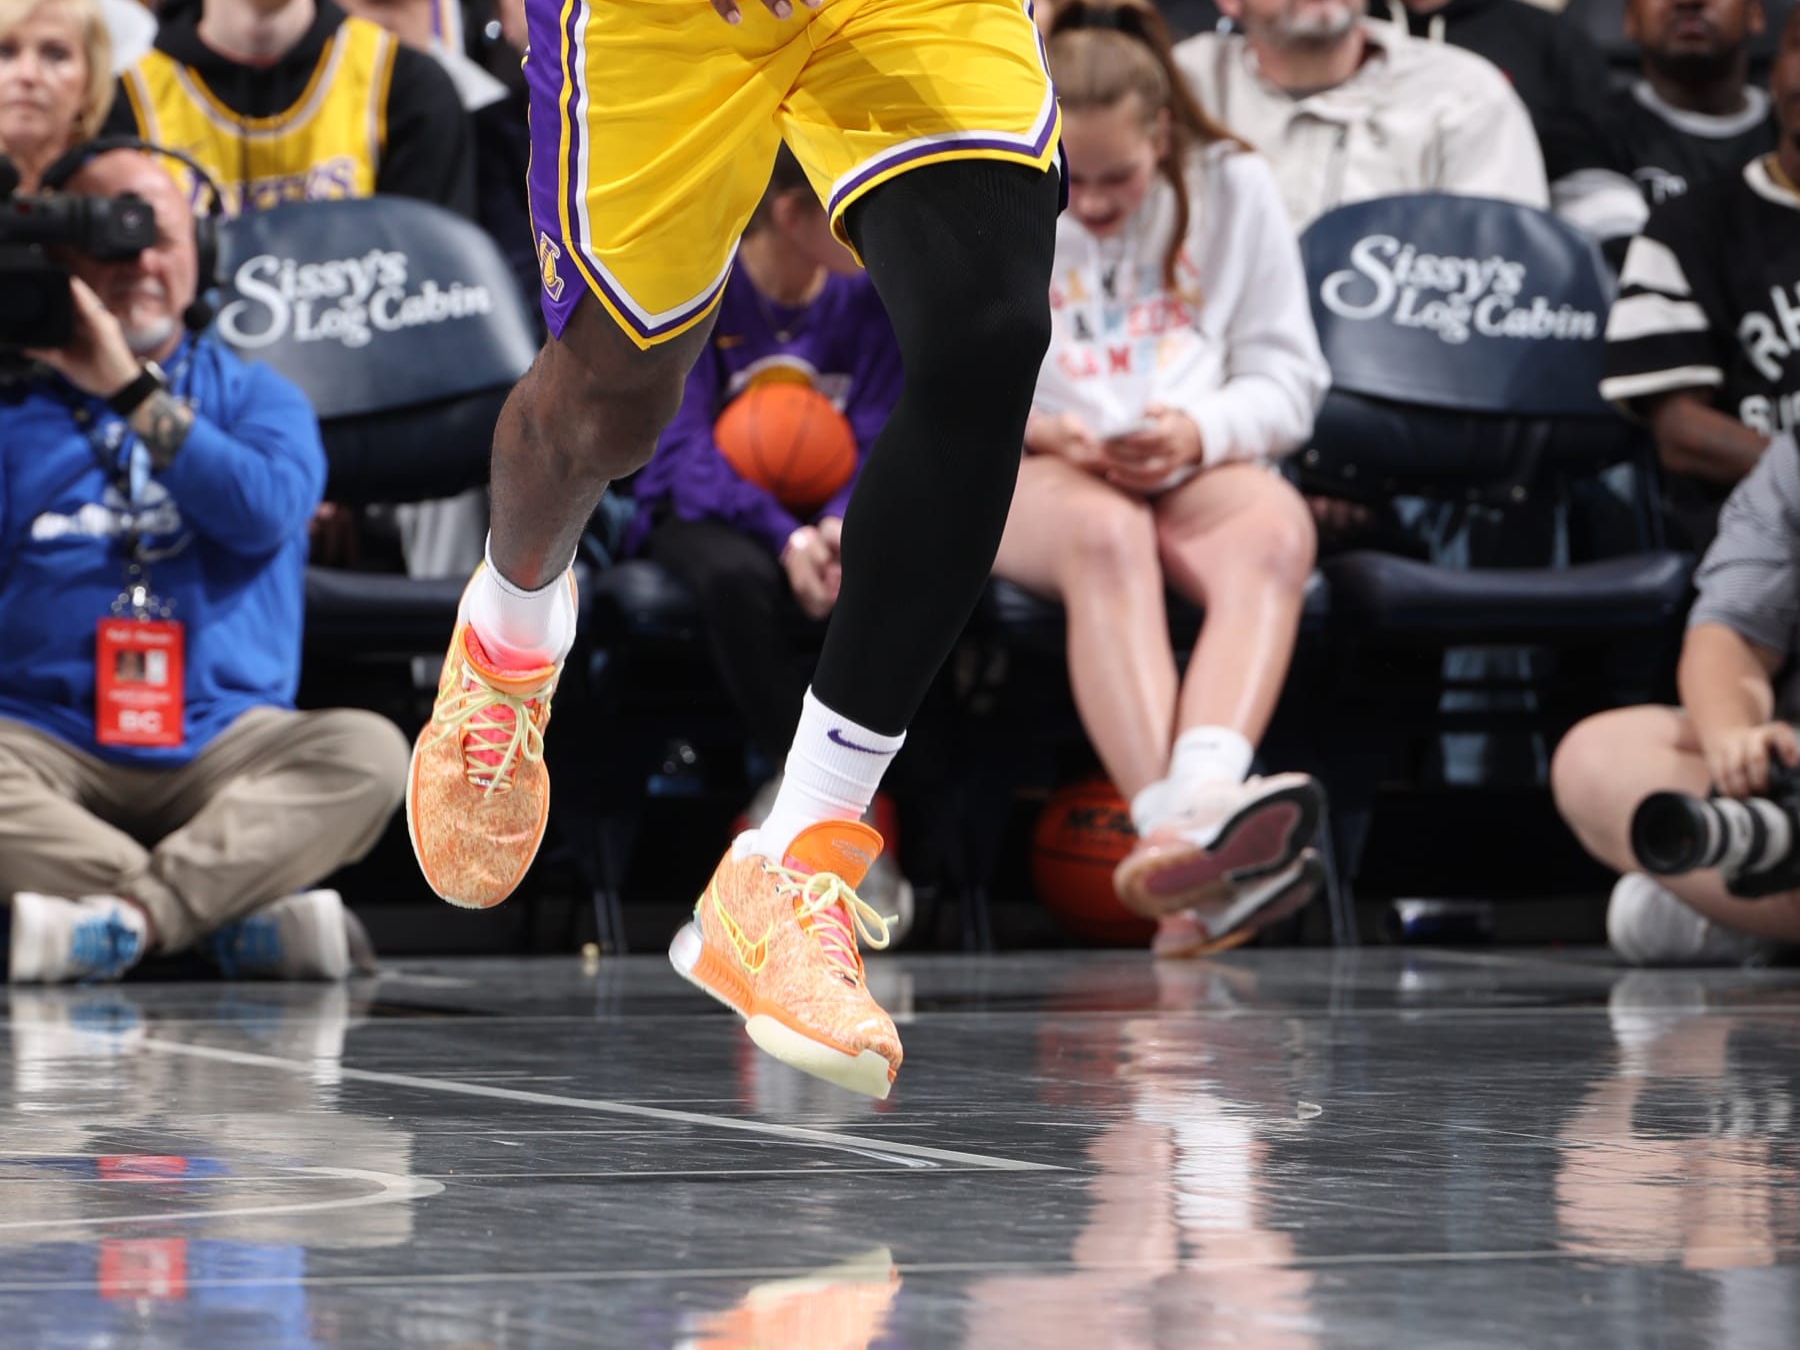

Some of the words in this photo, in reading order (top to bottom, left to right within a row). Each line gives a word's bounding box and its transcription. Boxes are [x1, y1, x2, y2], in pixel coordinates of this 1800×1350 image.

[217, 249, 408, 349] Sissy's
[293, 300, 372, 348] Log
[369, 280, 491, 332] Cabin
[1320, 234, 1526, 320] Sissy's
[1393, 287, 1472, 345] Log
[1474, 295, 1597, 340] Cabin
